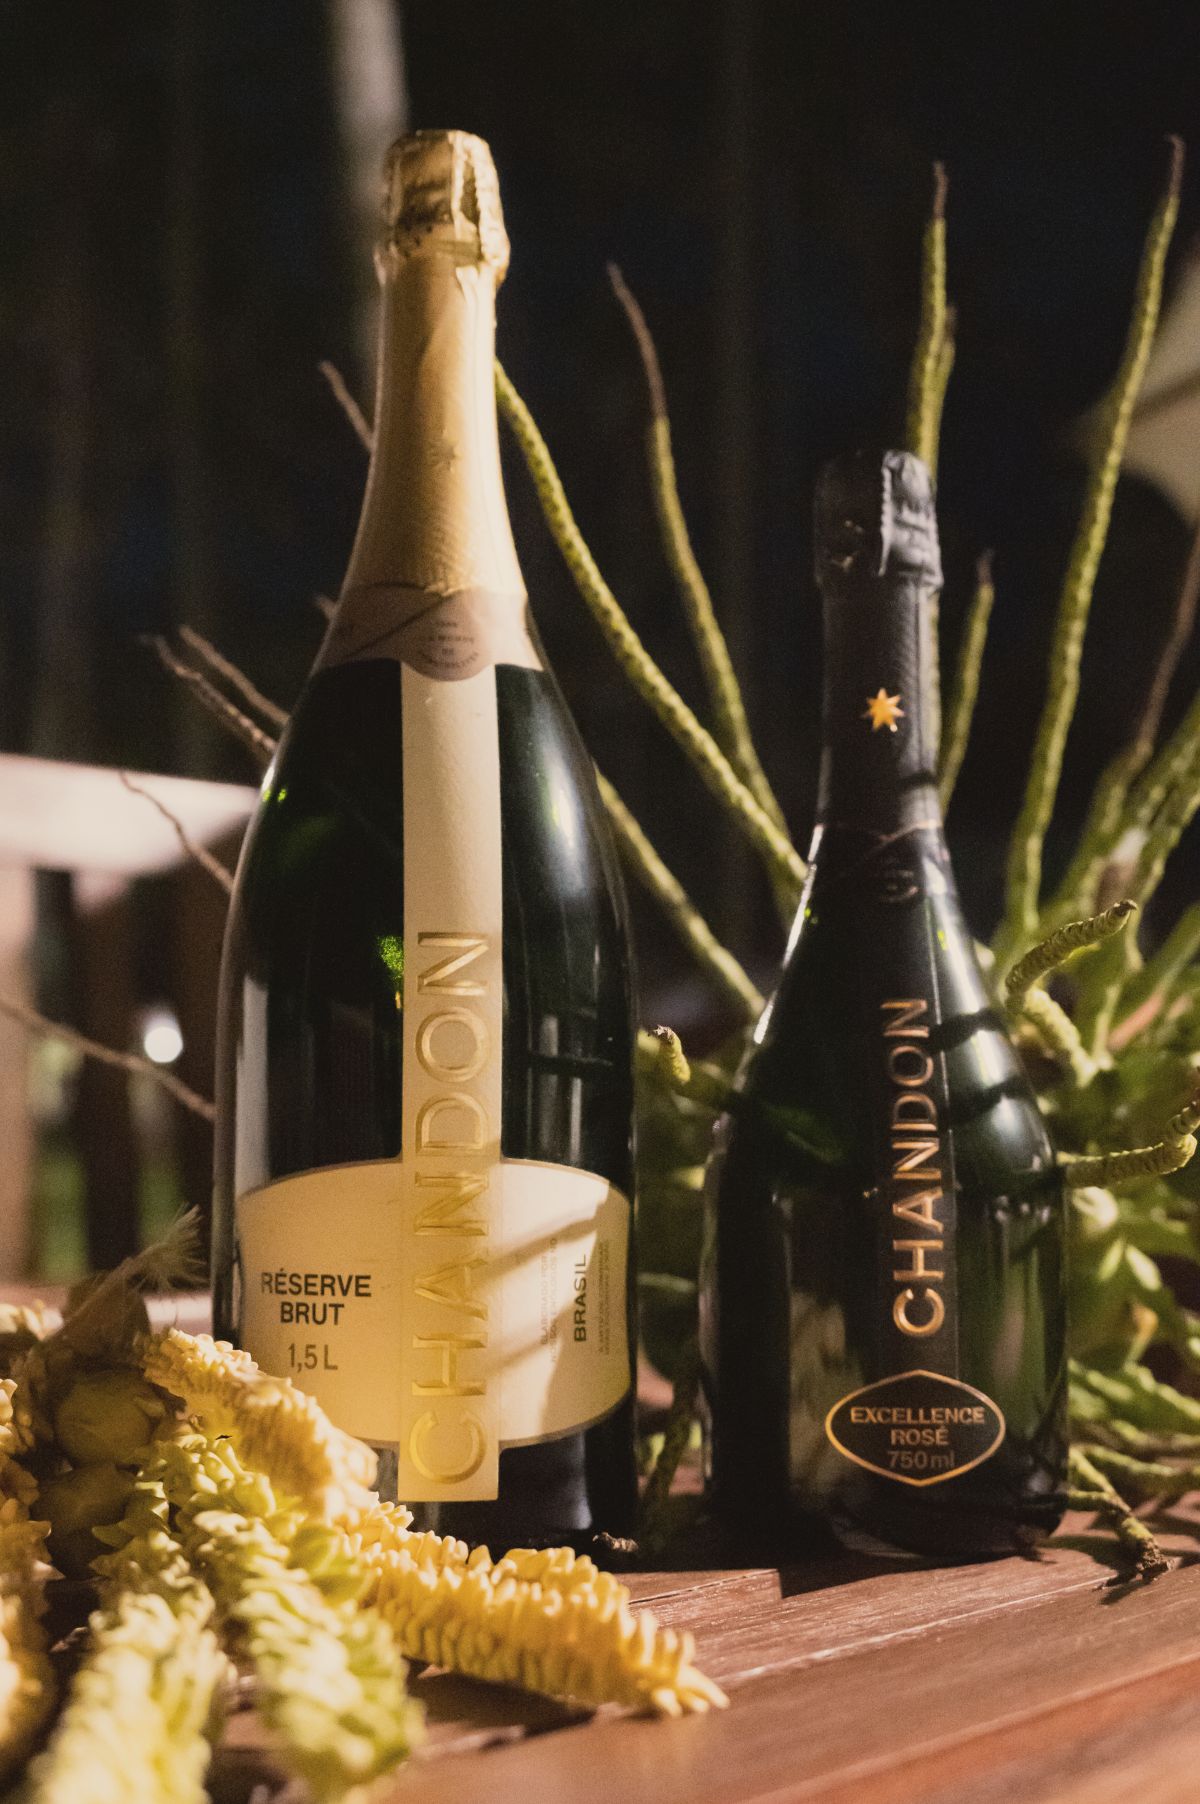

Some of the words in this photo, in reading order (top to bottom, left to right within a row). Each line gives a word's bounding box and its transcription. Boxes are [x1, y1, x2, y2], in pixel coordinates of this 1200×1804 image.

[880, 999, 945, 1338] CHANDON
[409, 931, 489, 1484] CHANDON
[261, 1268, 372, 1298] RÉSERVE
[574, 1254, 587, 1342] BRASIL
[280, 1303, 345, 1326] BRUT
[850, 1406, 986, 1425] EXCELLENCE
[890, 1425, 950, 1446] ROSÉ
